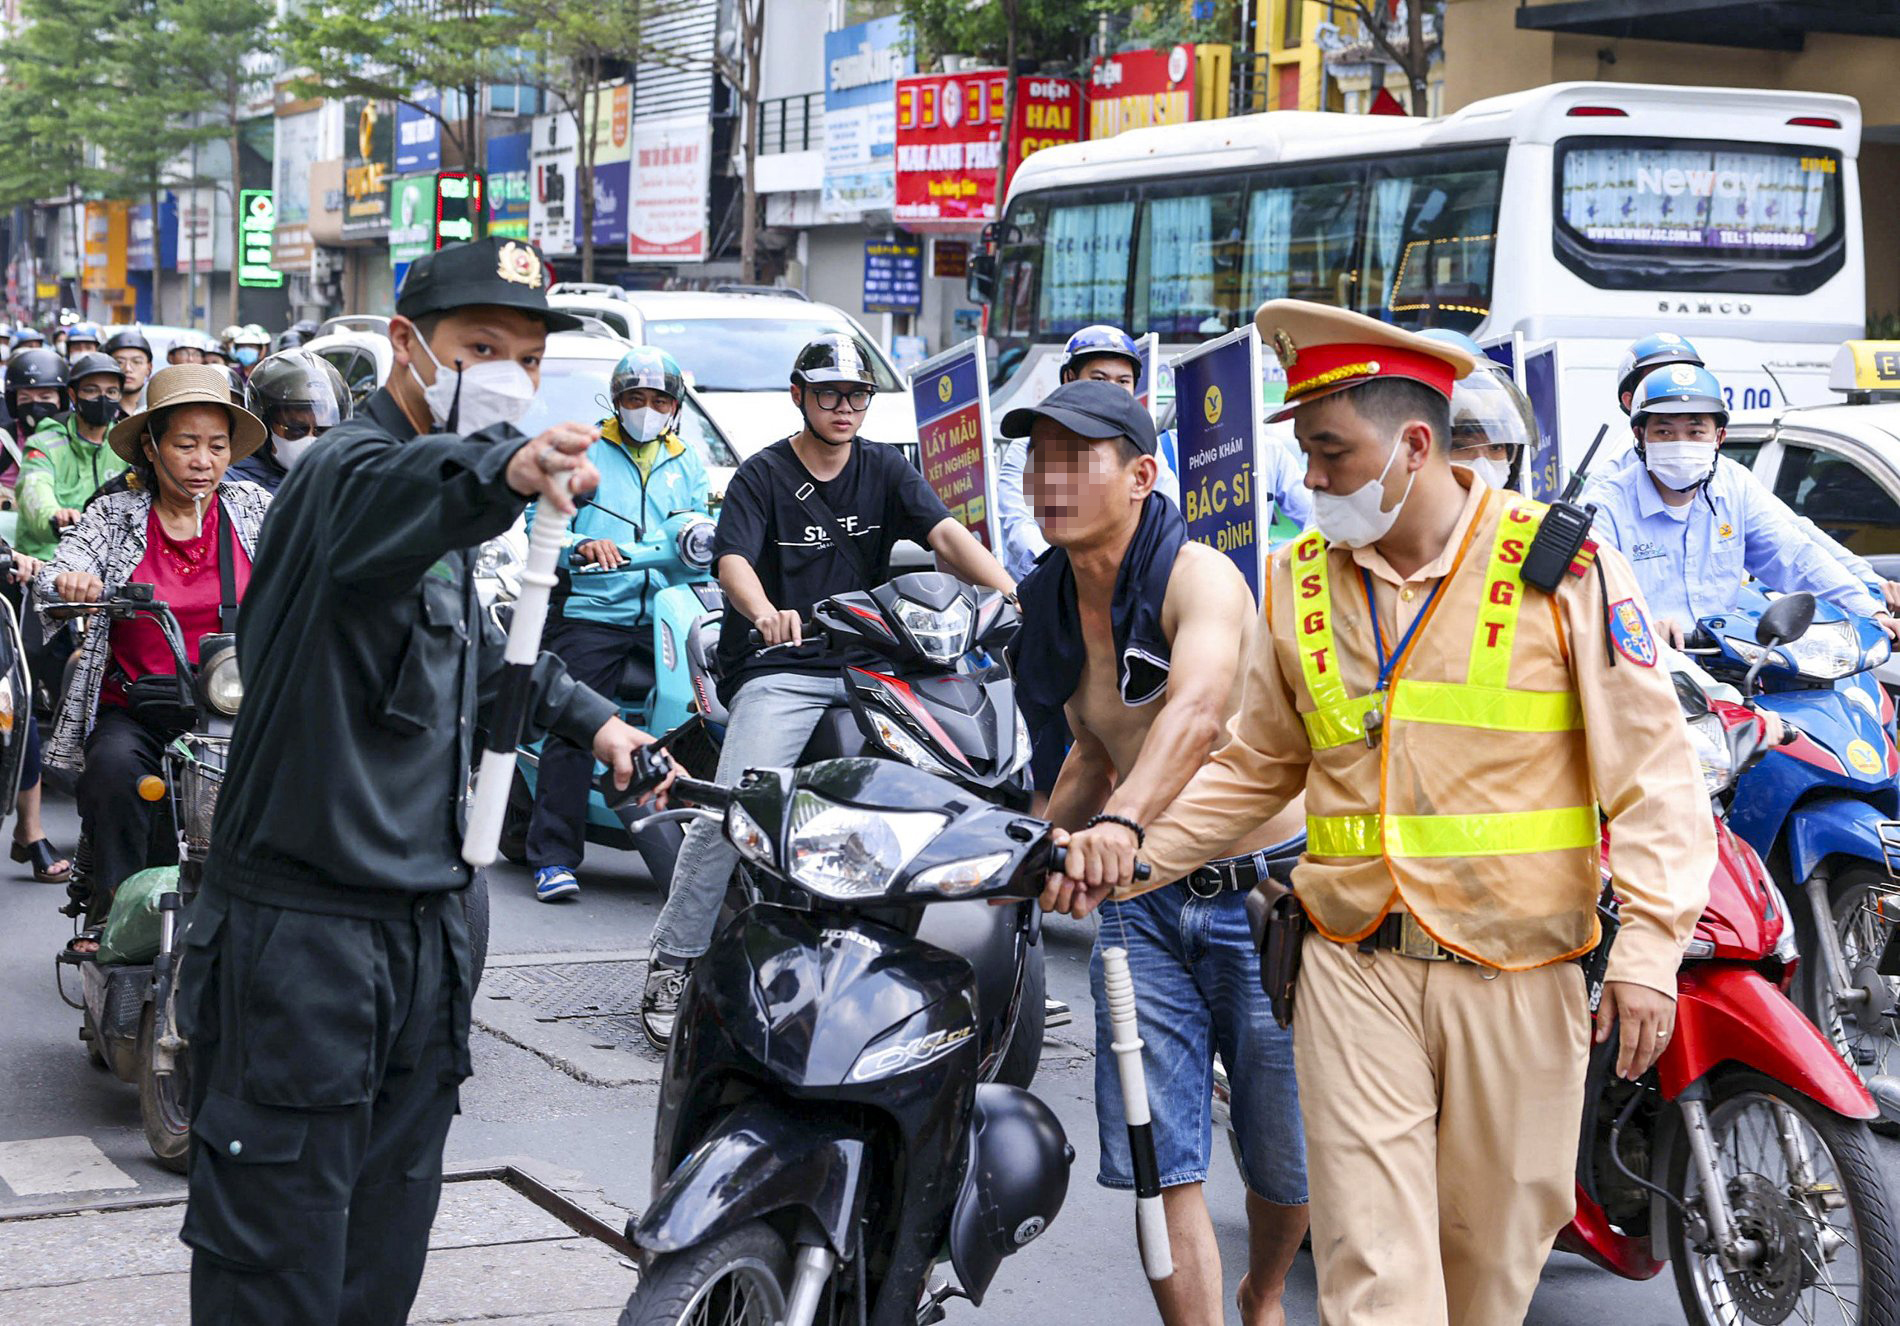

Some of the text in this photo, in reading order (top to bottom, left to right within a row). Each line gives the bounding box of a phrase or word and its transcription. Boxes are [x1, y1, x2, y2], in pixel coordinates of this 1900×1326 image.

[1029, 79, 1070, 102] ĐIỆN
[1026, 104, 1071, 130] HAI
[1658, 301, 1751, 315] SAMCO
[924, 415, 977, 458] LẤY MẪU
[928, 447, 980, 482] XÉT NGHIỆM
[1189, 437, 1243, 470] PHÒNG KHÁM
[953, 472, 973, 496] NHÀ
[1545, 456, 1558, 491] SĨ
[1186, 463, 1250, 523] BÁC SĨ
[1217, 520, 1253, 553] ĐÌNH
[1298, 538, 1328, 674] CSGT
[820, 929, 882, 953] HONDA
